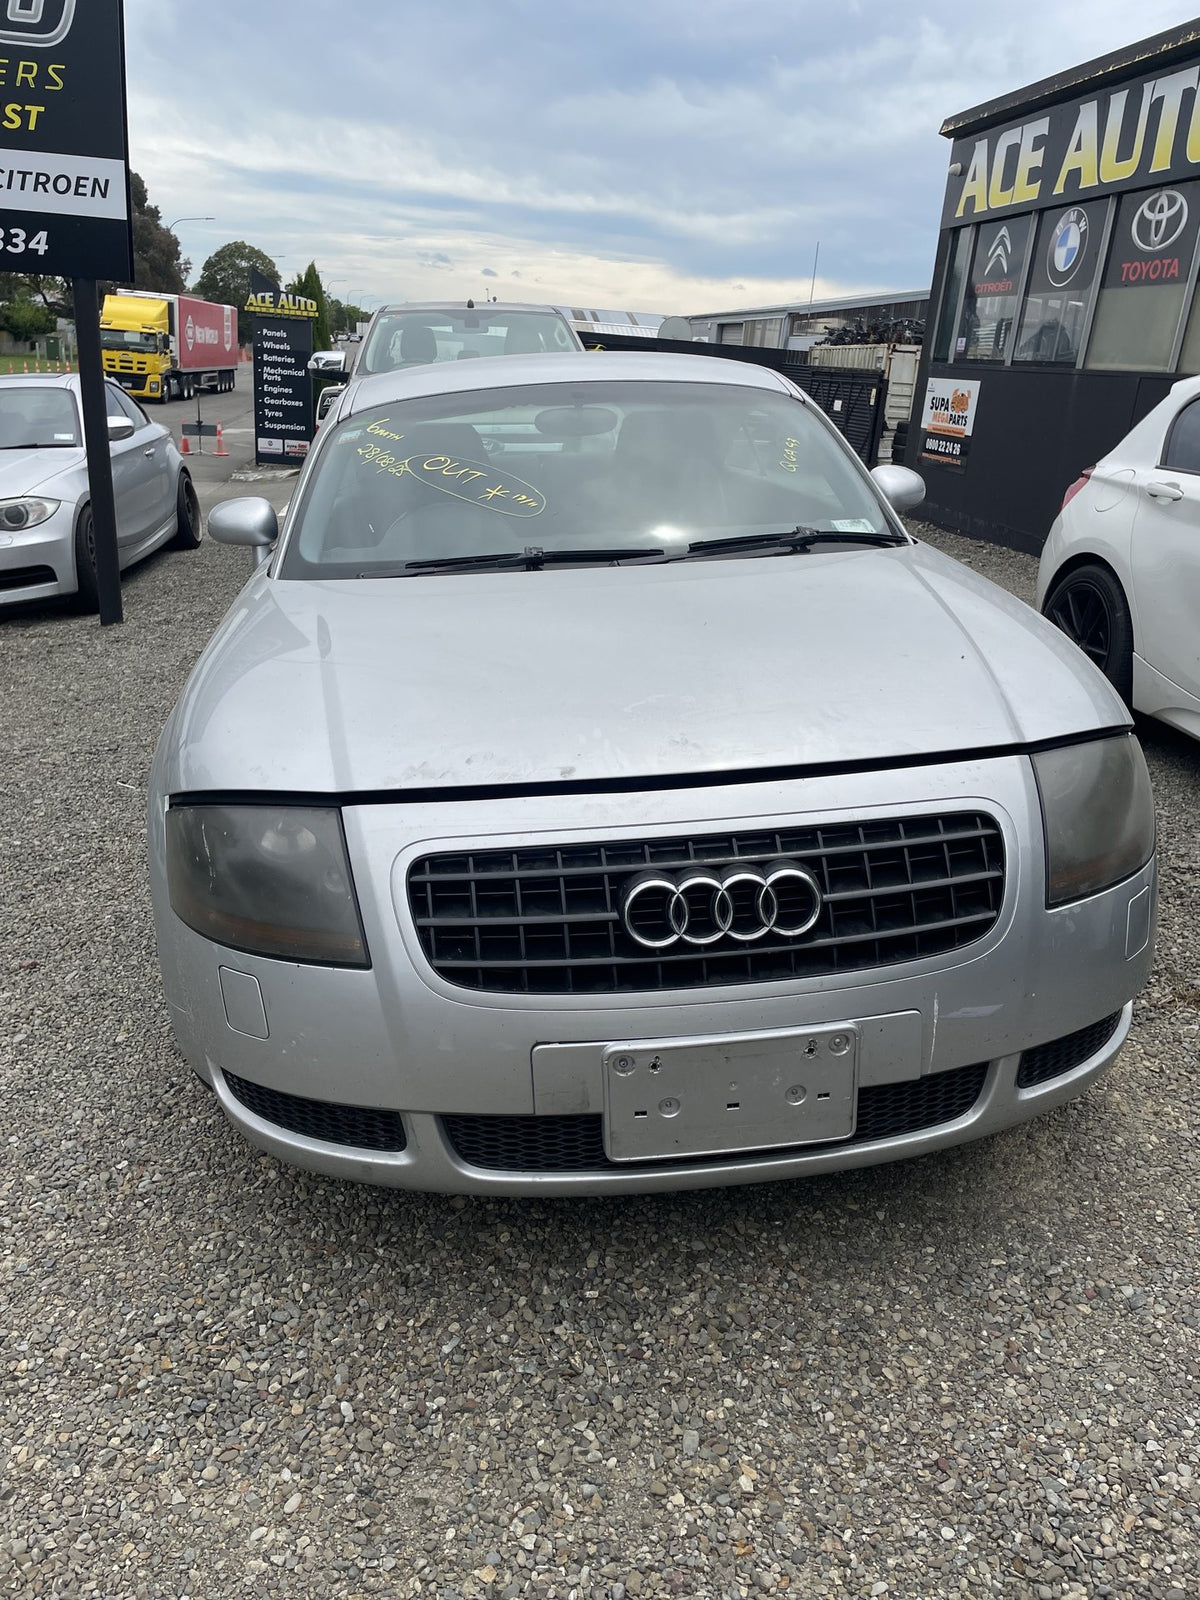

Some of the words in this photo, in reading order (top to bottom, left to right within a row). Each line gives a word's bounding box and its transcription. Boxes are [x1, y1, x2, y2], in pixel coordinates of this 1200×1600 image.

[2, 103, 45, 131] ST
[954, 116, 1050, 218] ACE
[1056, 210, 1088, 236] BMW
[0, 227, 48, 255] 34
[1121, 258, 1179, 281] TOYOTA
[246, 292, 274, 307] ACE
[278, 293, 317, 311] AUTO
[263, 329, 287, 338] Panels
[263, 341, 290, 350] Wheels
[263, 354, 295, 364] Batteries
[263, 366, 305, 376] Mechanical
[264, 385, 293, 394] Engines
[264, 397, 303, 407] Gearboxes
[929, 396, 950, 412] SUPA
[264, 409, 283, 417] Tyres
[264, 421, 306, 431] Suspension
[926, 438, 938, 450] 0800
[939, 440, 946, 452] 22
[947, 442, 953, 454] 24
[953, 443, 961, 455] 26
[423, 456, 488, 484] OUT
